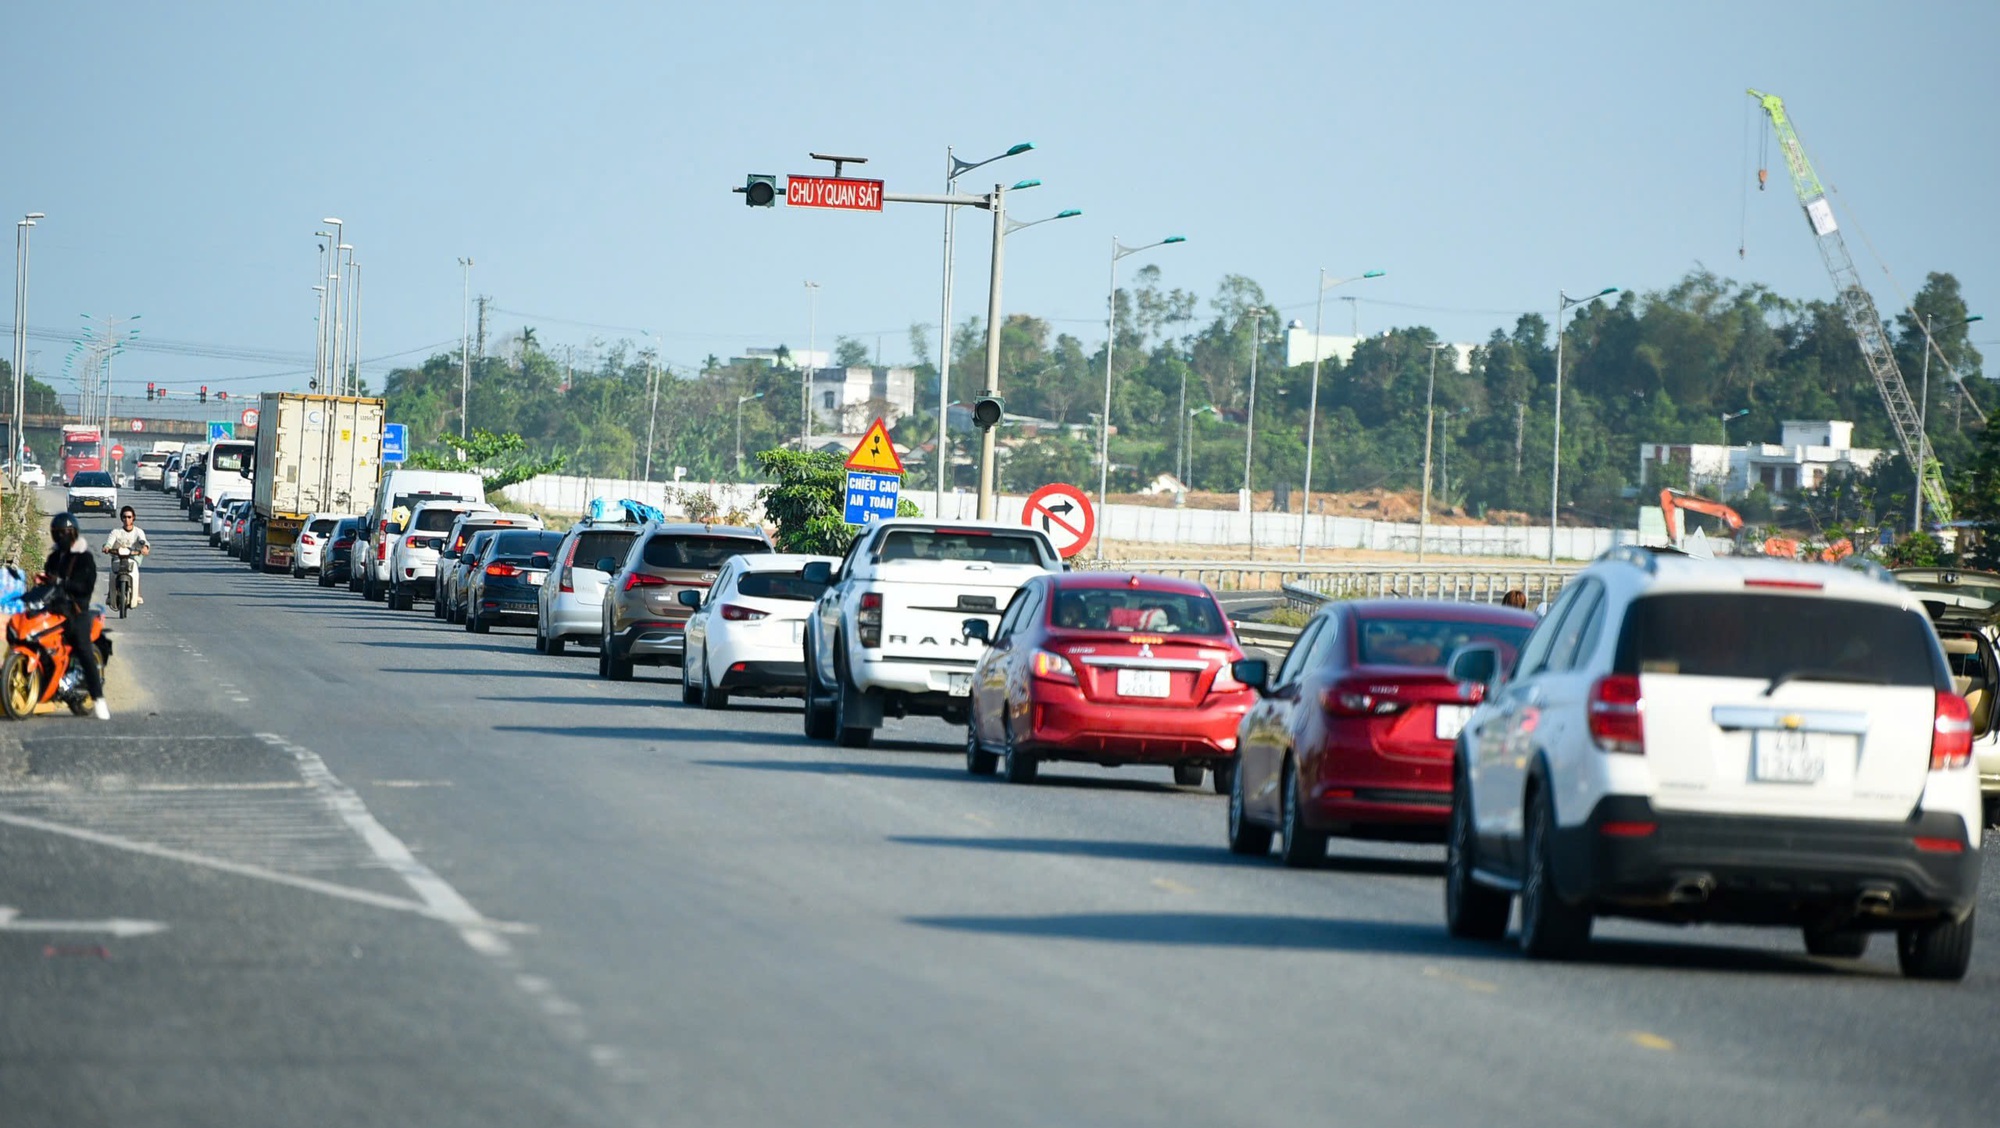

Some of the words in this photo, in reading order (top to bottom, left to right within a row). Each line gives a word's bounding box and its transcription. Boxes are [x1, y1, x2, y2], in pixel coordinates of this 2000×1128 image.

[790, 178, 814, 203] CHÚ
[816, 179, 824, 204] Ý
[825, 184, 856, 206] QUAN
[858, 182, 879, 208] SÁT
[879, 480, 898, 494] CAO
[850, 494, 864, 507] AN
[889, 634, 972, 647] RAN
